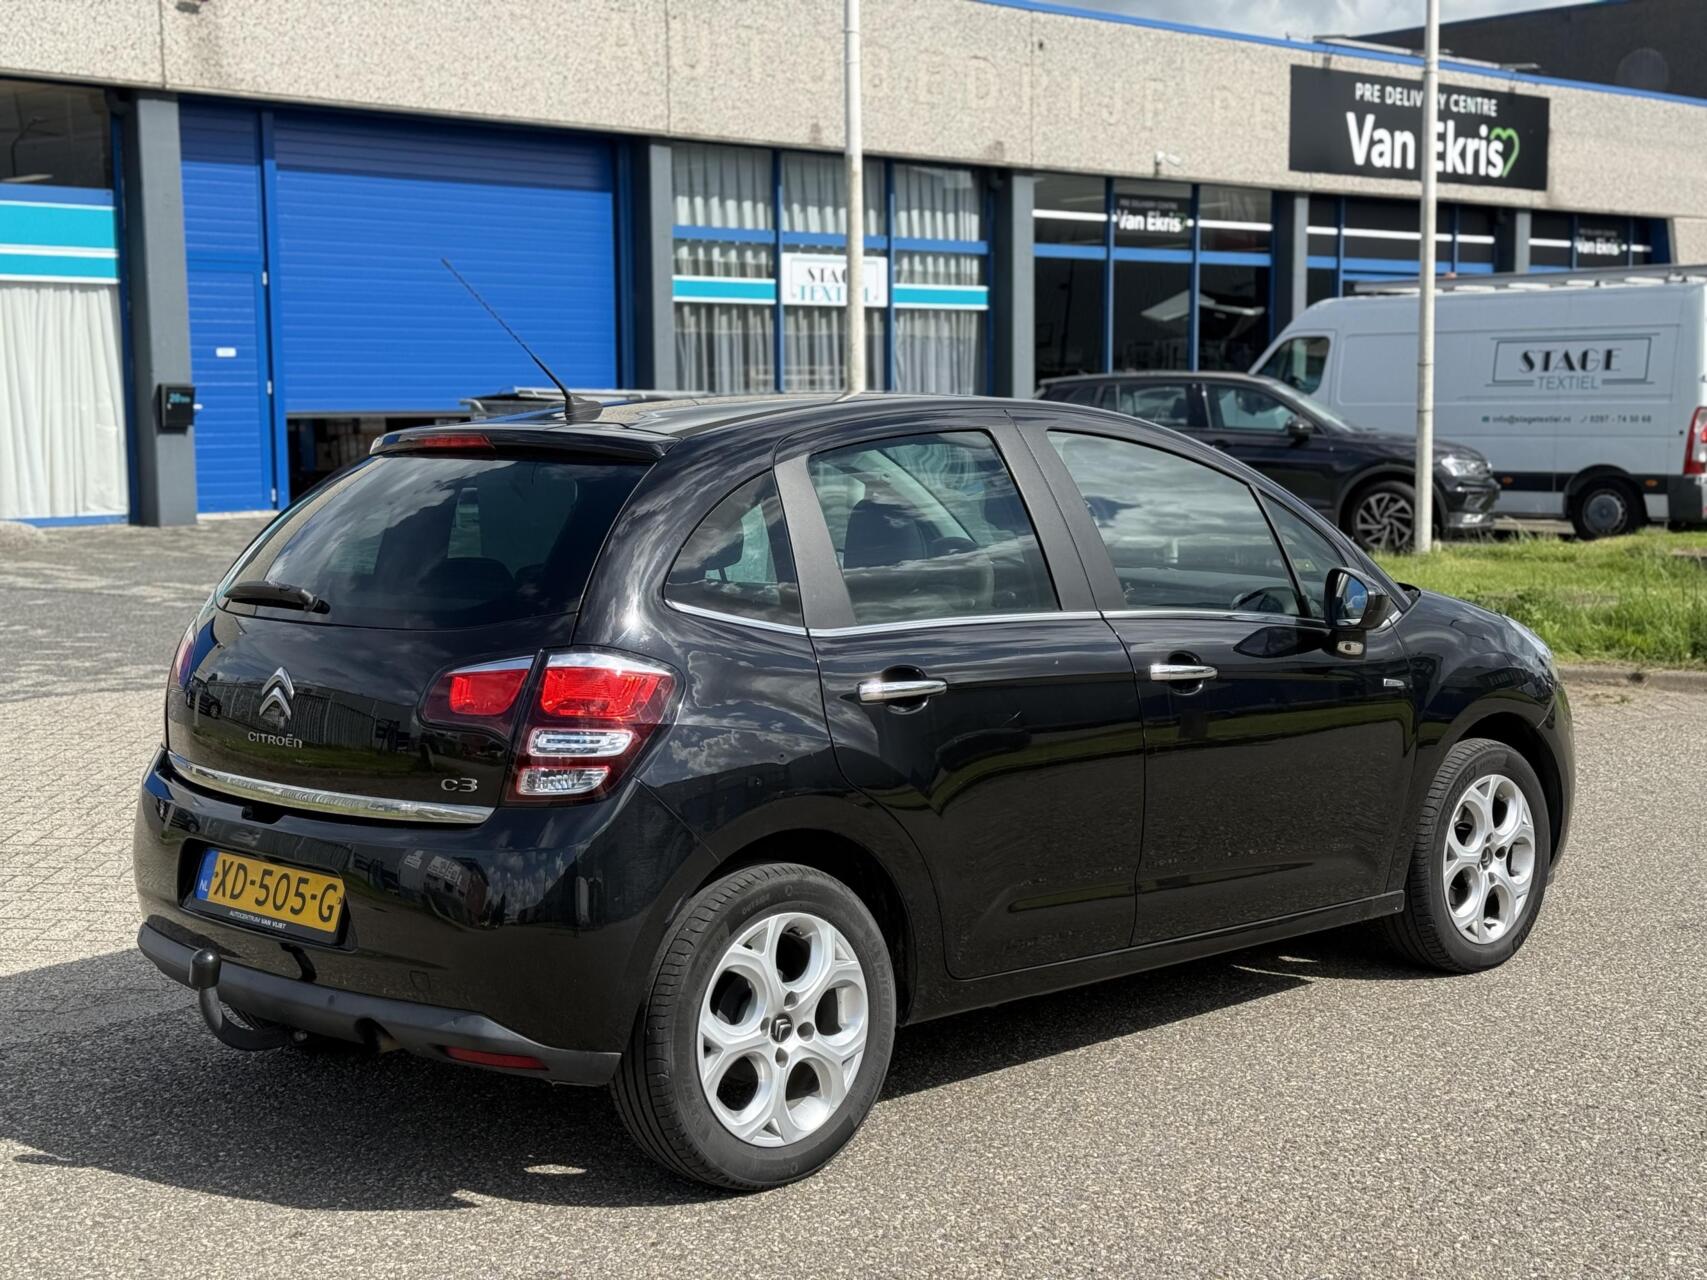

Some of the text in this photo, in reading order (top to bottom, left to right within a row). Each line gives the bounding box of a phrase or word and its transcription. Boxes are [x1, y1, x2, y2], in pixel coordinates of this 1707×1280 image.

[1354, 82, 1498, 117] PRE DELIVY CENTRE
[1346, 111, 1505, 178] Van Ekris
[1117, 209, 1182, 233] Van Ekris
[800, 285, 870, 302] TEXTL
[1519, 348, 1622, 373] STAGE
[1536, 375, 1599, 390] TEXTIEL
[440, 778, 478, 792] C3
[198, 859, 338, 923] NL XD-505-G
